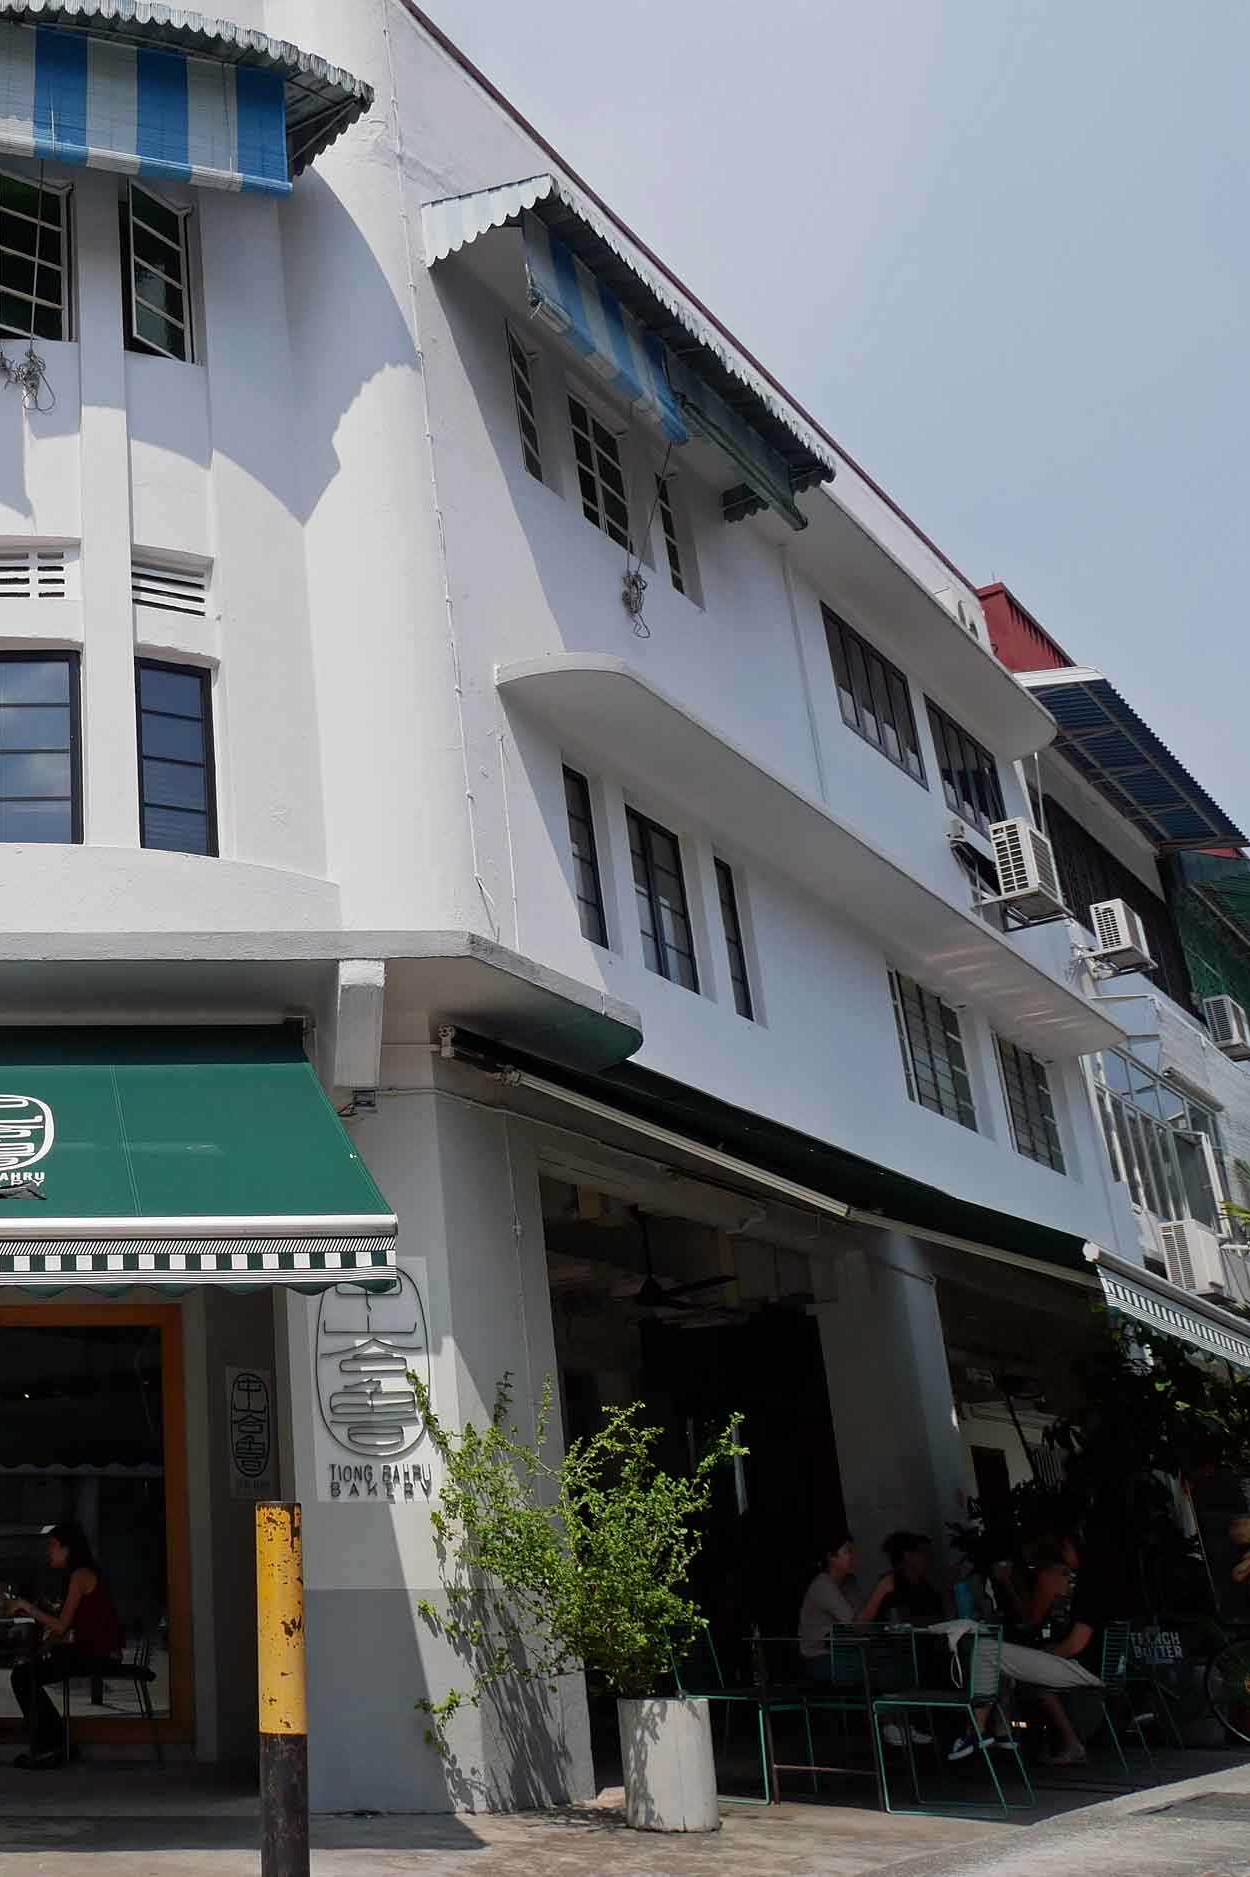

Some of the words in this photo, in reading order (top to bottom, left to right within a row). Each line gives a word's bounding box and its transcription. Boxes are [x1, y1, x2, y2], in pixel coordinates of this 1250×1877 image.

[329, 1463, 374, 1482] TIONG
[382, 1463, 432, 1483] BAHRU
[330, 1481, 432, 1500] BAKERY
[1130, 1631, 1181, 1646] FRNCH
